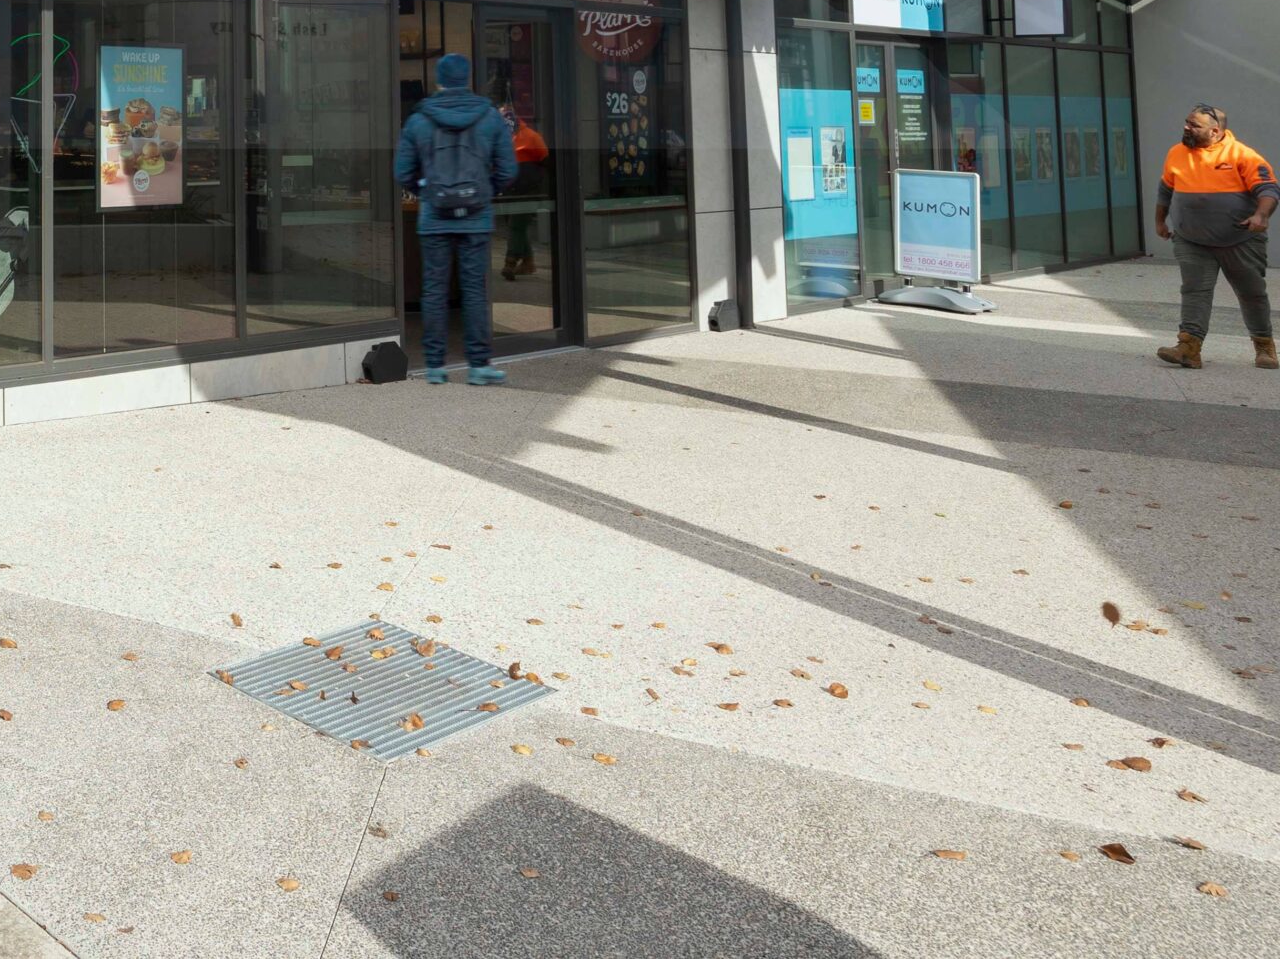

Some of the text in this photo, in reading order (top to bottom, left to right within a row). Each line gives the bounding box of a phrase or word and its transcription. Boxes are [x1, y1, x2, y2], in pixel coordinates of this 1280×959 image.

[591, 38, 645, 58] BAKEHOUSE
[121, 51, 160, 64] WAKE UP
[112, 64, 169, 83] SUNSHINE
[899, 75, 923, 88] KUMON
[606, 91, 629, 114] $26
[902, 200, 970, 218] KUMON
[917, 256, 937, 266] 1800
